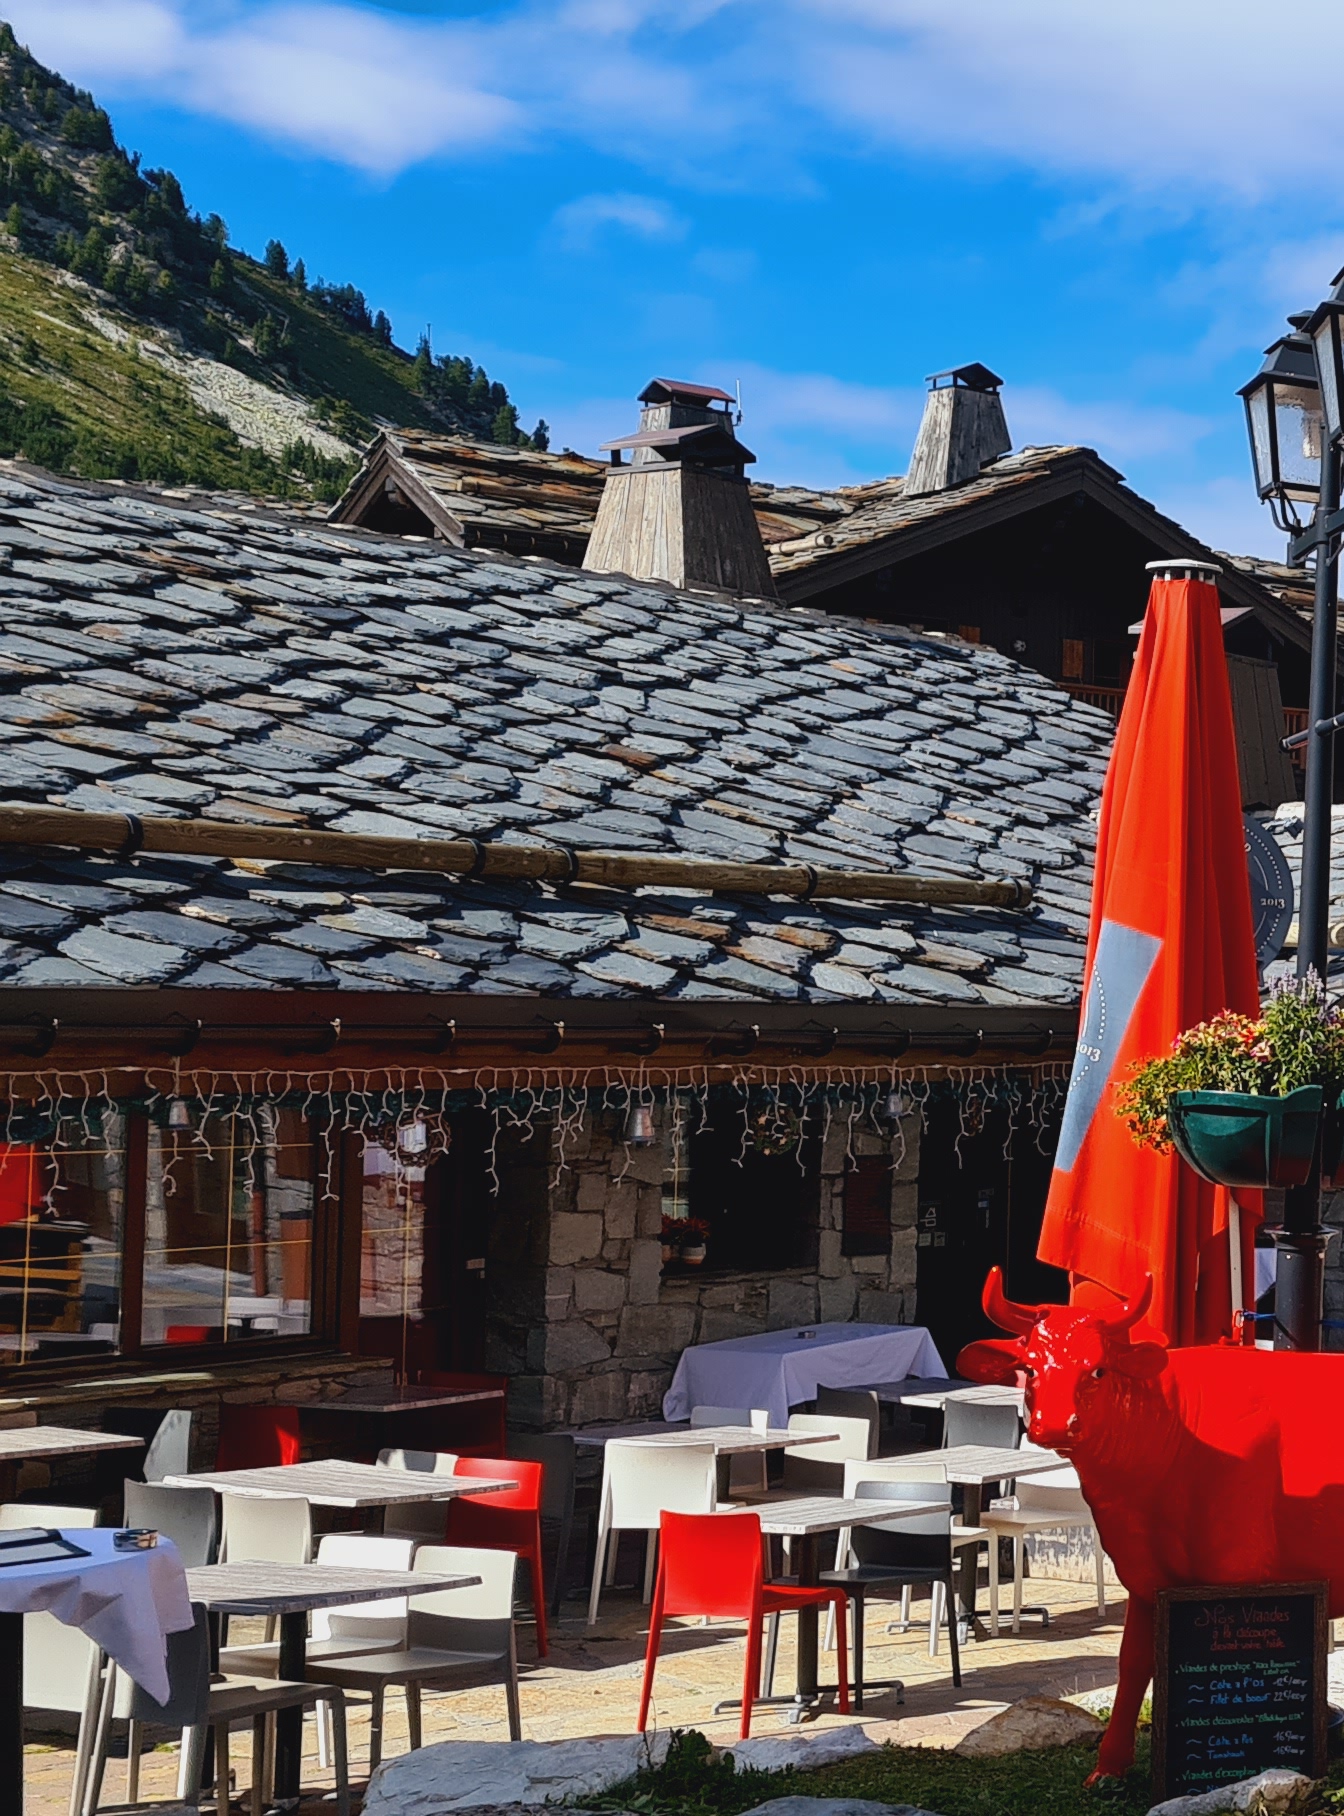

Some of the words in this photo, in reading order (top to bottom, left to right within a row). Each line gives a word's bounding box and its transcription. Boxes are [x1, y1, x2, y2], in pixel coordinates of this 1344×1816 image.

[1260, 898, 1286, 909] 2013
[1194, 1604, 1234, 1627] Nos
[1242, 1603, 1290, 1623] Viandes
[1223, 1624, 1232, 1638] la
[1236, 1627, 1277, 1640] découpe
[1210, 1662, 1219, 1672] de
[1220, 1661, 1251, 1674] prestige
